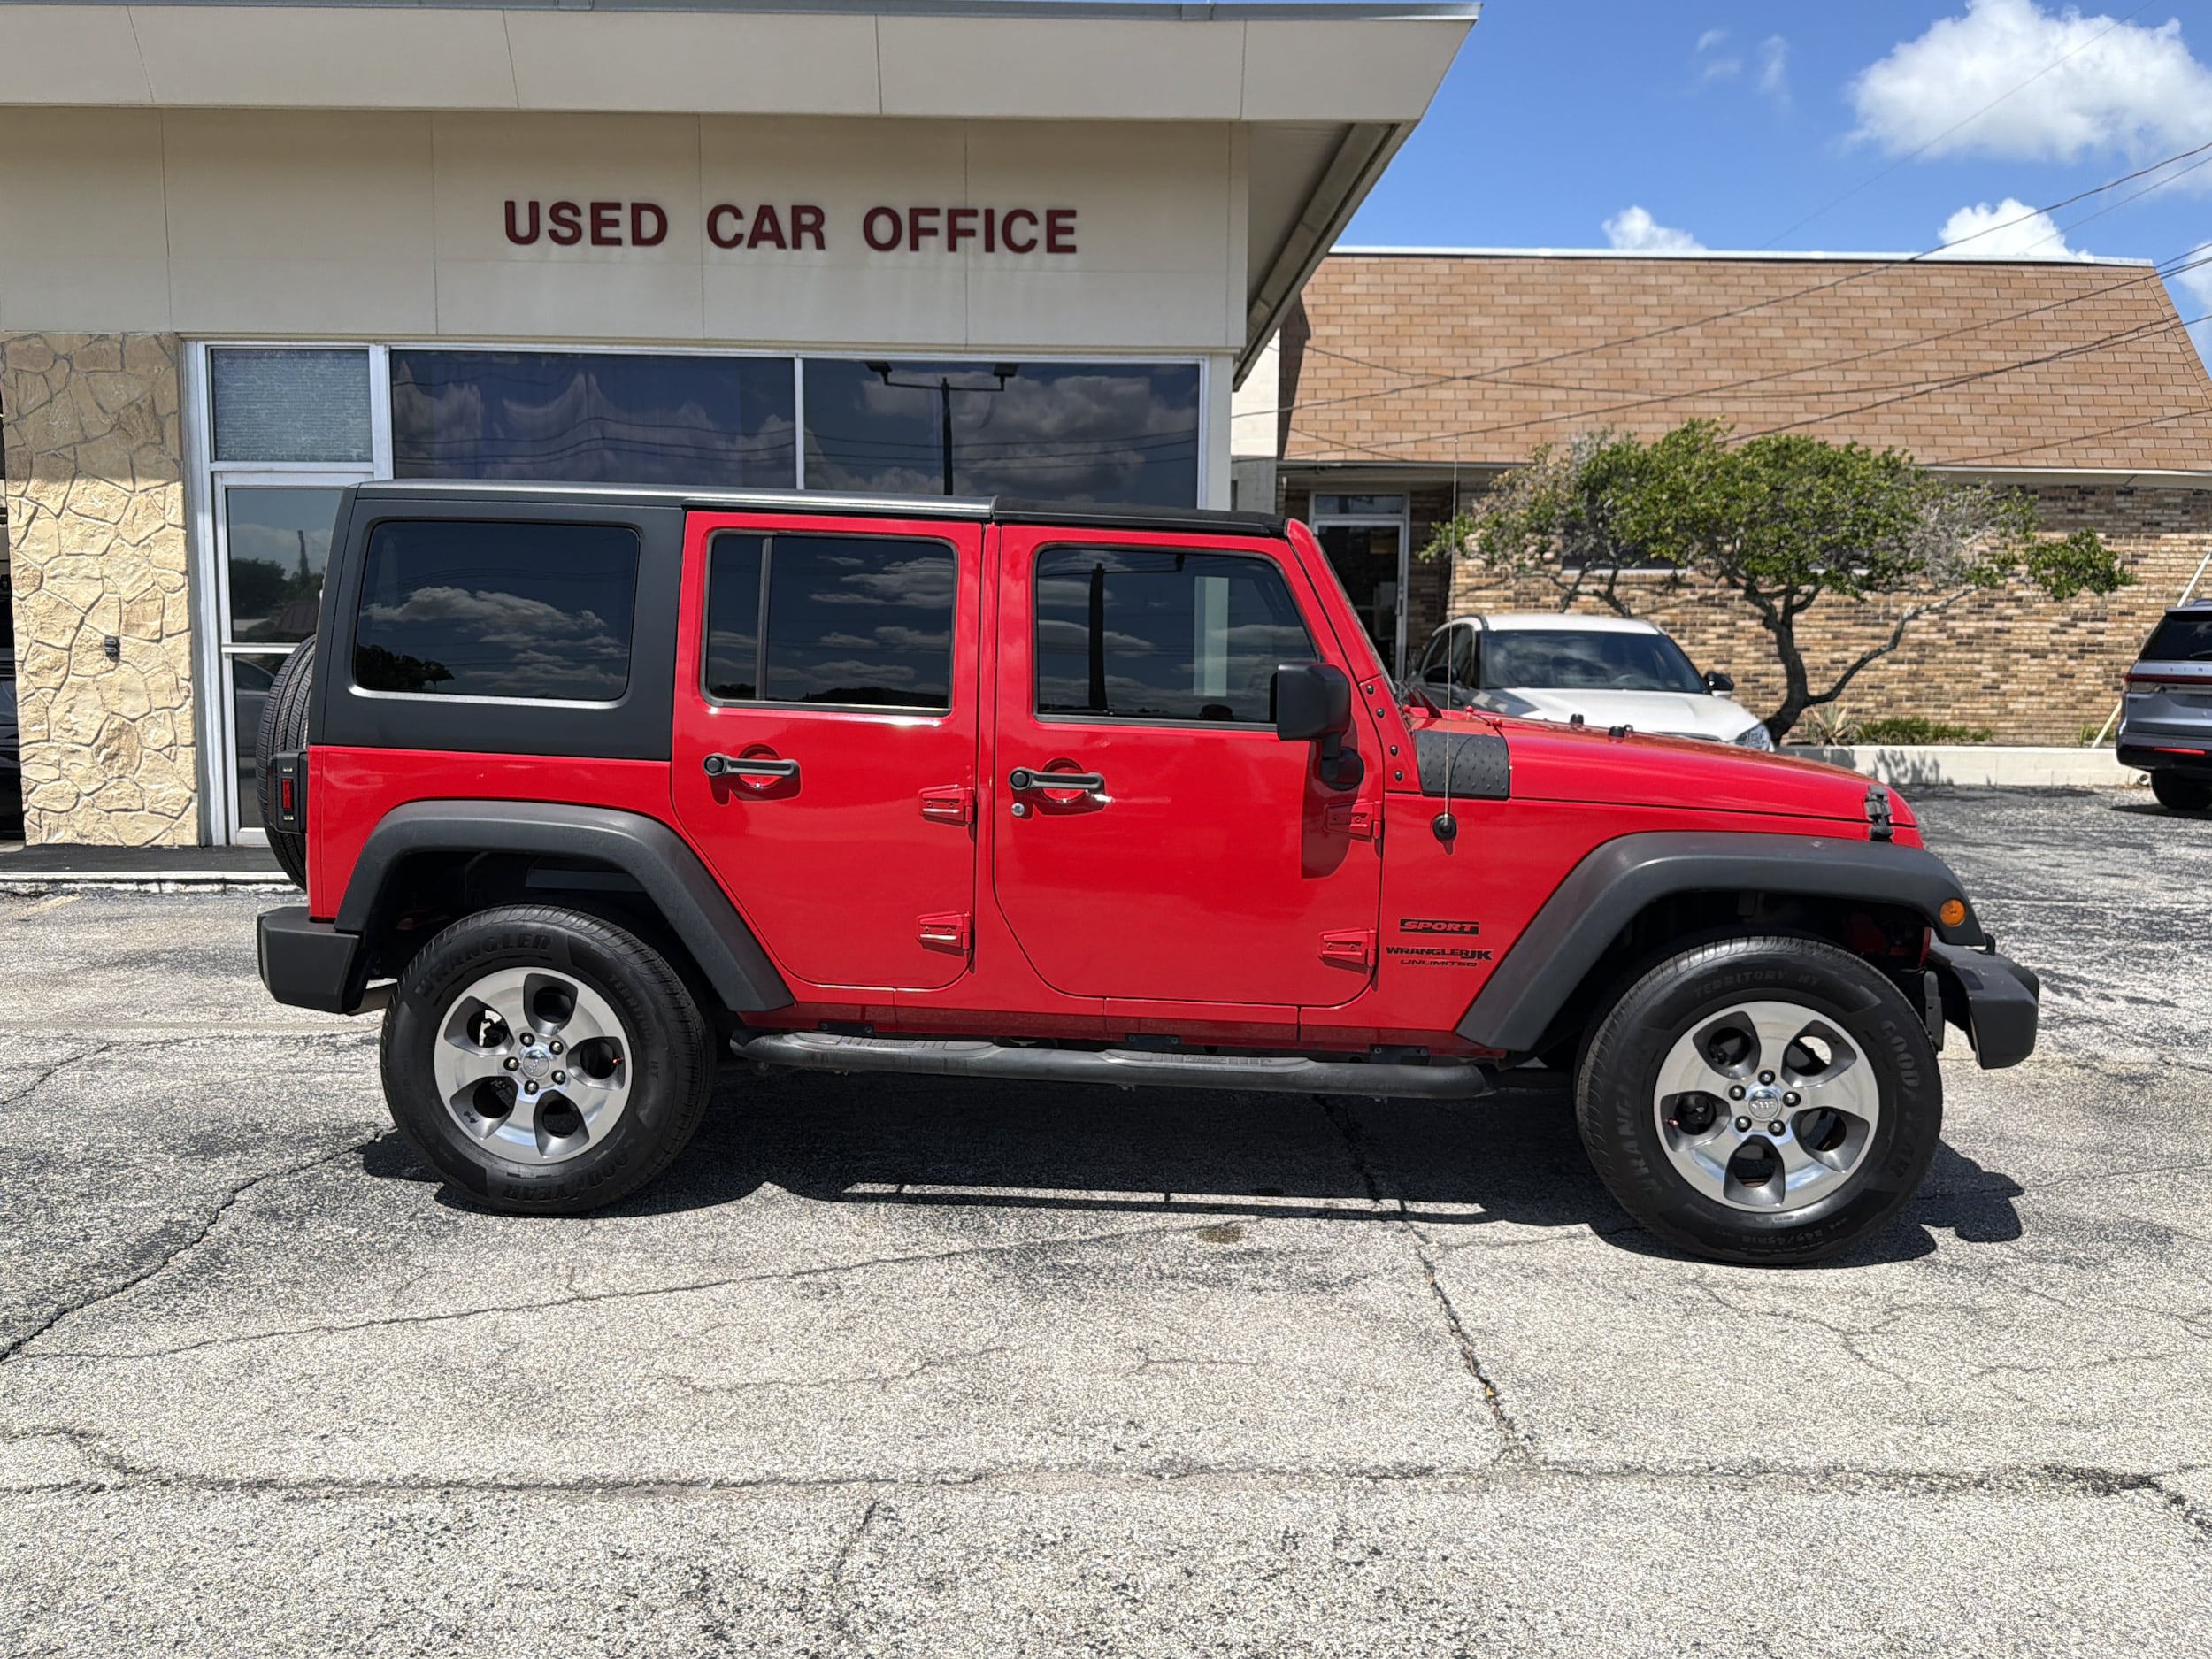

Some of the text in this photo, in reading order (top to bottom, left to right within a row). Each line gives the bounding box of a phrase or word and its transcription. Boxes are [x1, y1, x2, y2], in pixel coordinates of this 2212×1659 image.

[504, 200, 1078, 254] USED CAR OFFICE
[1402, 919, 1479, 933] SPORT
